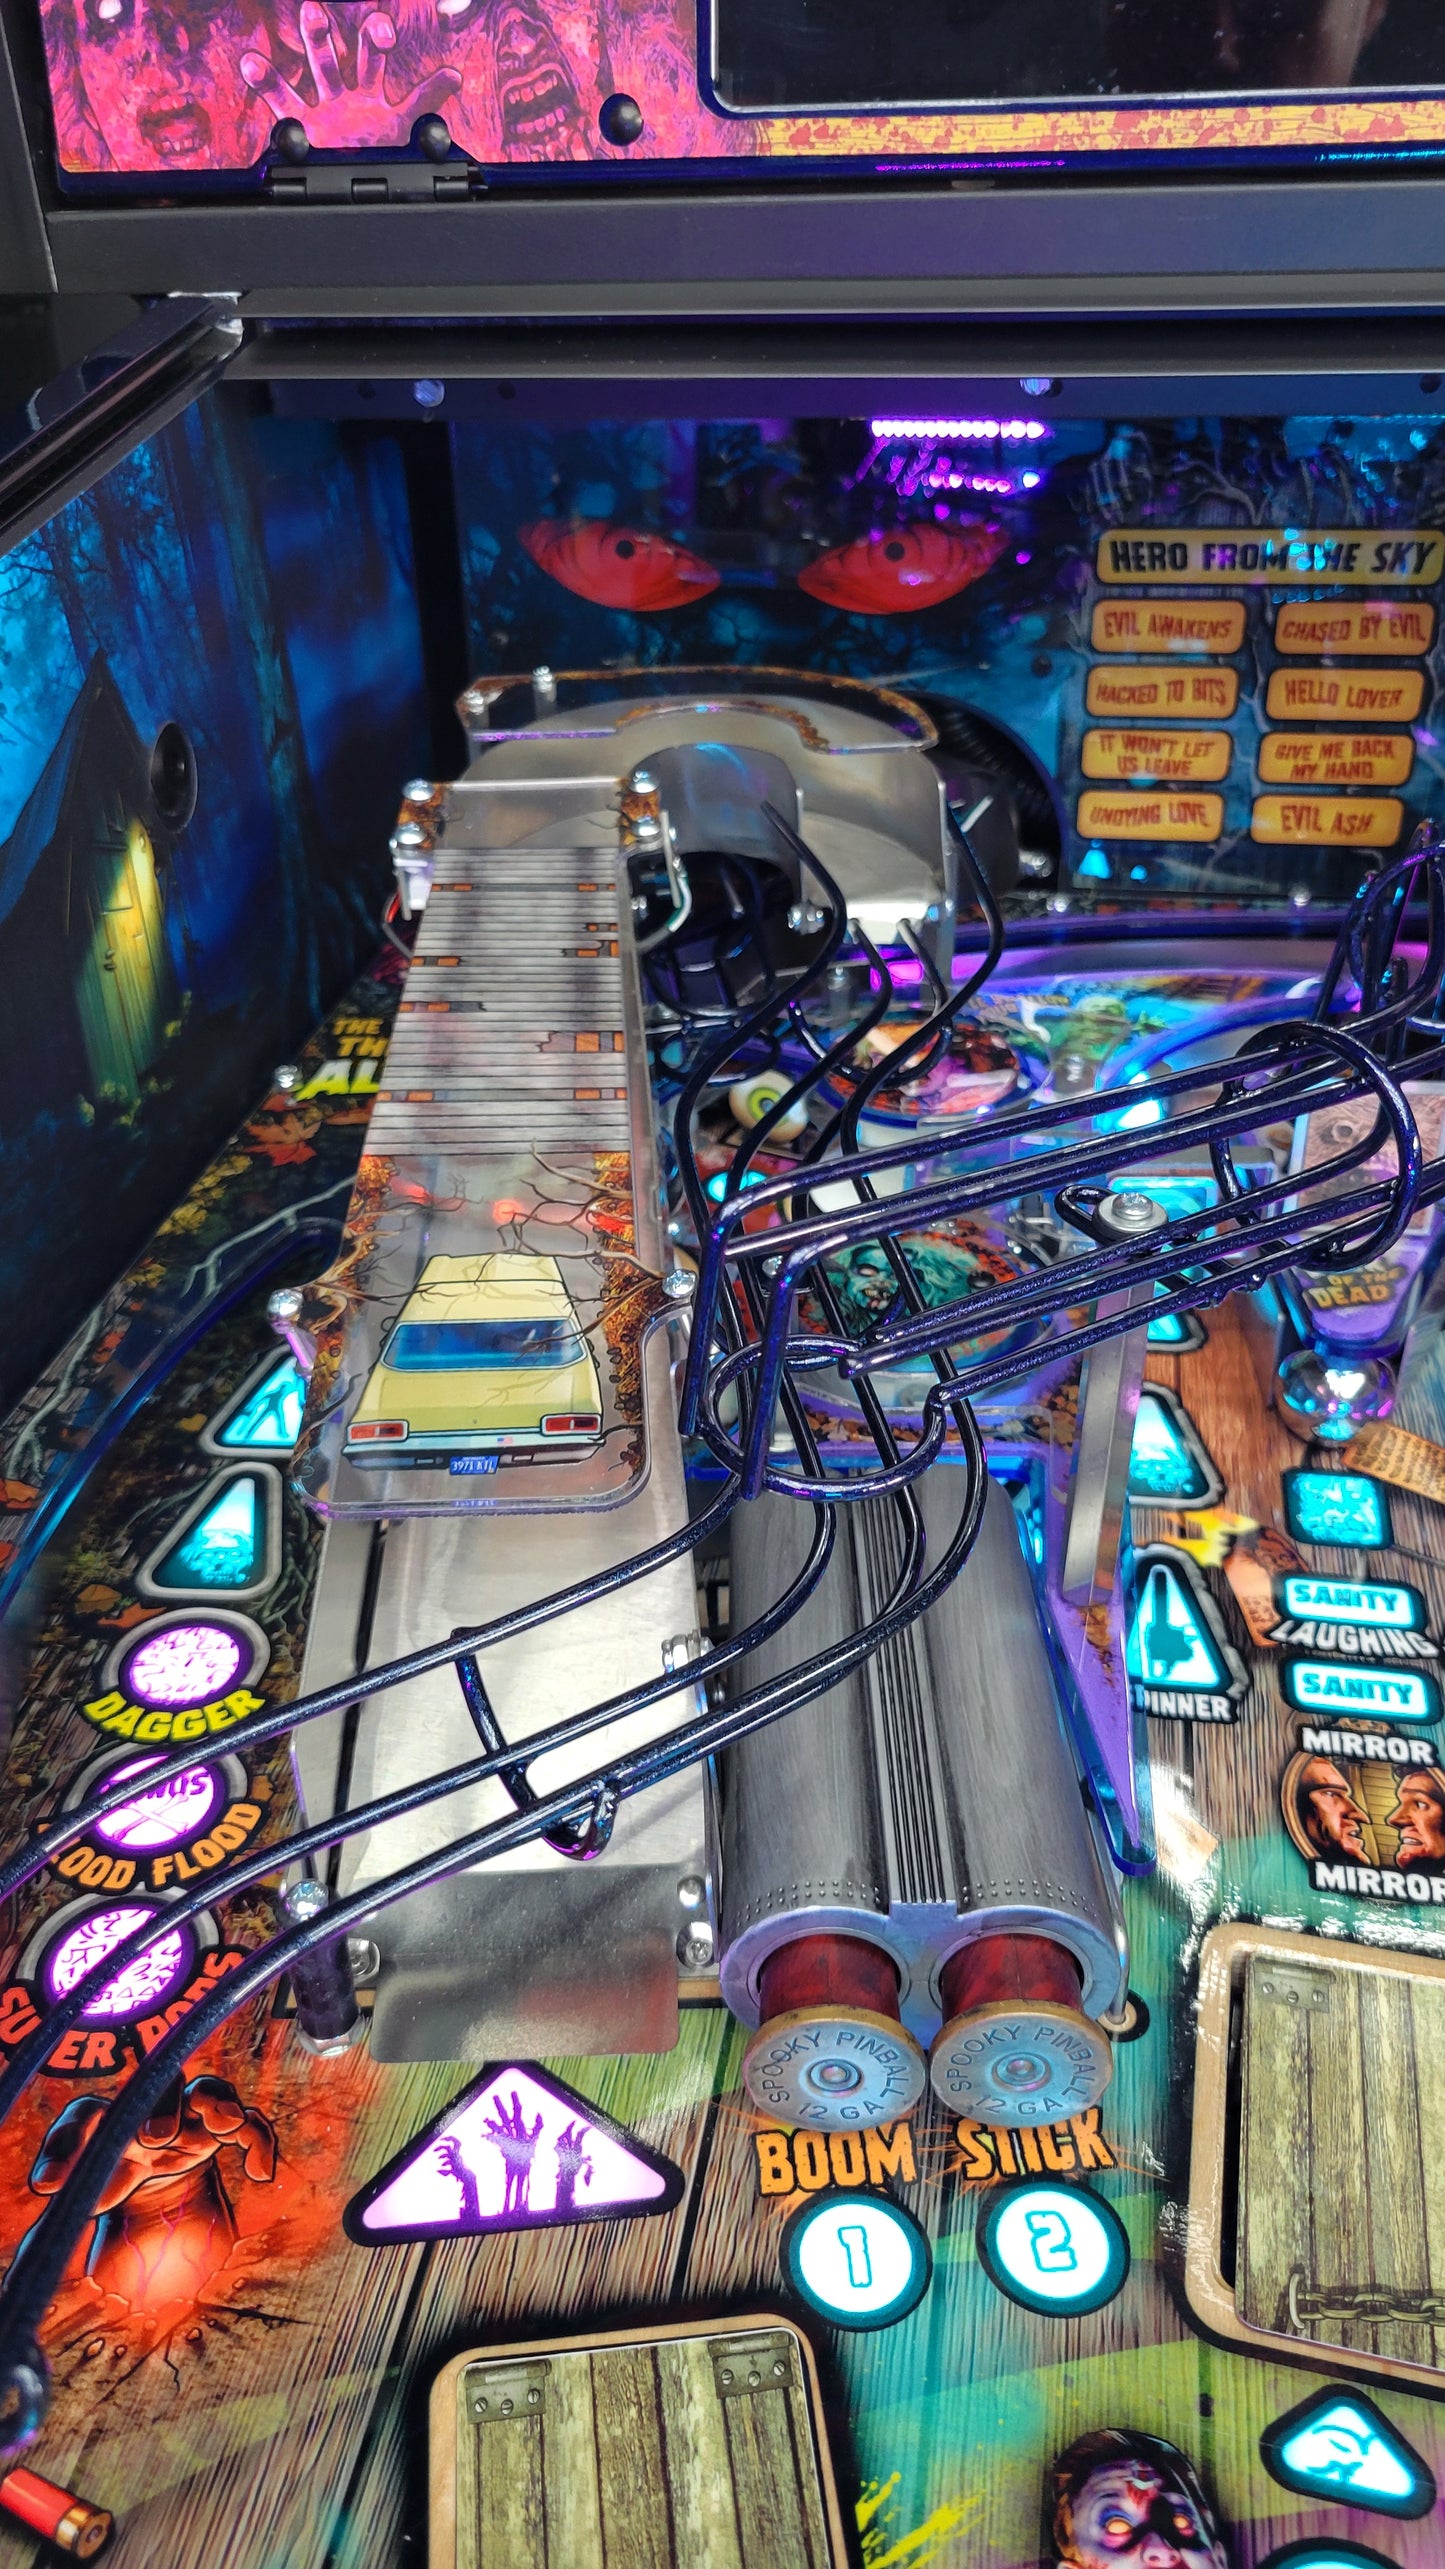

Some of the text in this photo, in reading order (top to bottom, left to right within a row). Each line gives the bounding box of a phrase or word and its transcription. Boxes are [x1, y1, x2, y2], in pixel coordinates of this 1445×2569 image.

[1109, 540, 1437, 574] HERO FROM THE SKY
[1104, 611, 1232, 639] EVIL AWAKENS
[1282, 613, 1426, 642] CHASED BY EVIL
[1097, 678, 1226, 706] HACKED TO BITS
[1285, 679, 1403, 709] HELLO LOVER
[1099, 734, 1215, 757] IT WON'T LET
[1274, 739, 1395, 760] GIVE ME BACK
[1117, 756, 1192, 775] US LEAVE
[1290, 761, 1374, 780] MY HAND
[1090, 802, 1209, 828] UNDYING LOVE
[1280, 805, 1374, 835] EVIL ASH
[333, 1018, 383, 1035] THE
[1308, 1284, 1390, 1308] DEAD
[1294, 1583, 1399, 1611] SANITY
[1269, 1619, 1440, 1658] LAUGHING
[1303, 1673, 1412, 1704] SANITY
[84, 1689, 266, 1742] DAGGER
[1302, 1726, 1434, 1766] MIRROR
[152, 1803, 263, 1887] FLOOD
[1315, 1861, 1445, 1902] MIRROR
[0, 1986, 118, 2070] SUER
[762, 2030, 910, 2103] SPOOKY PINBALL
[947, 2025, 1097, 2097] SPOOKY PINBALL
[799, 2099, 885, 2120] 12 GA
[976, 2094, 1064, 2115] 12 GA
[755, 2105, 1119, 2198] BOOM STICK
[1025, 2210, 1077, 2272] 2
[838, 2225, 873, 2288] 1
